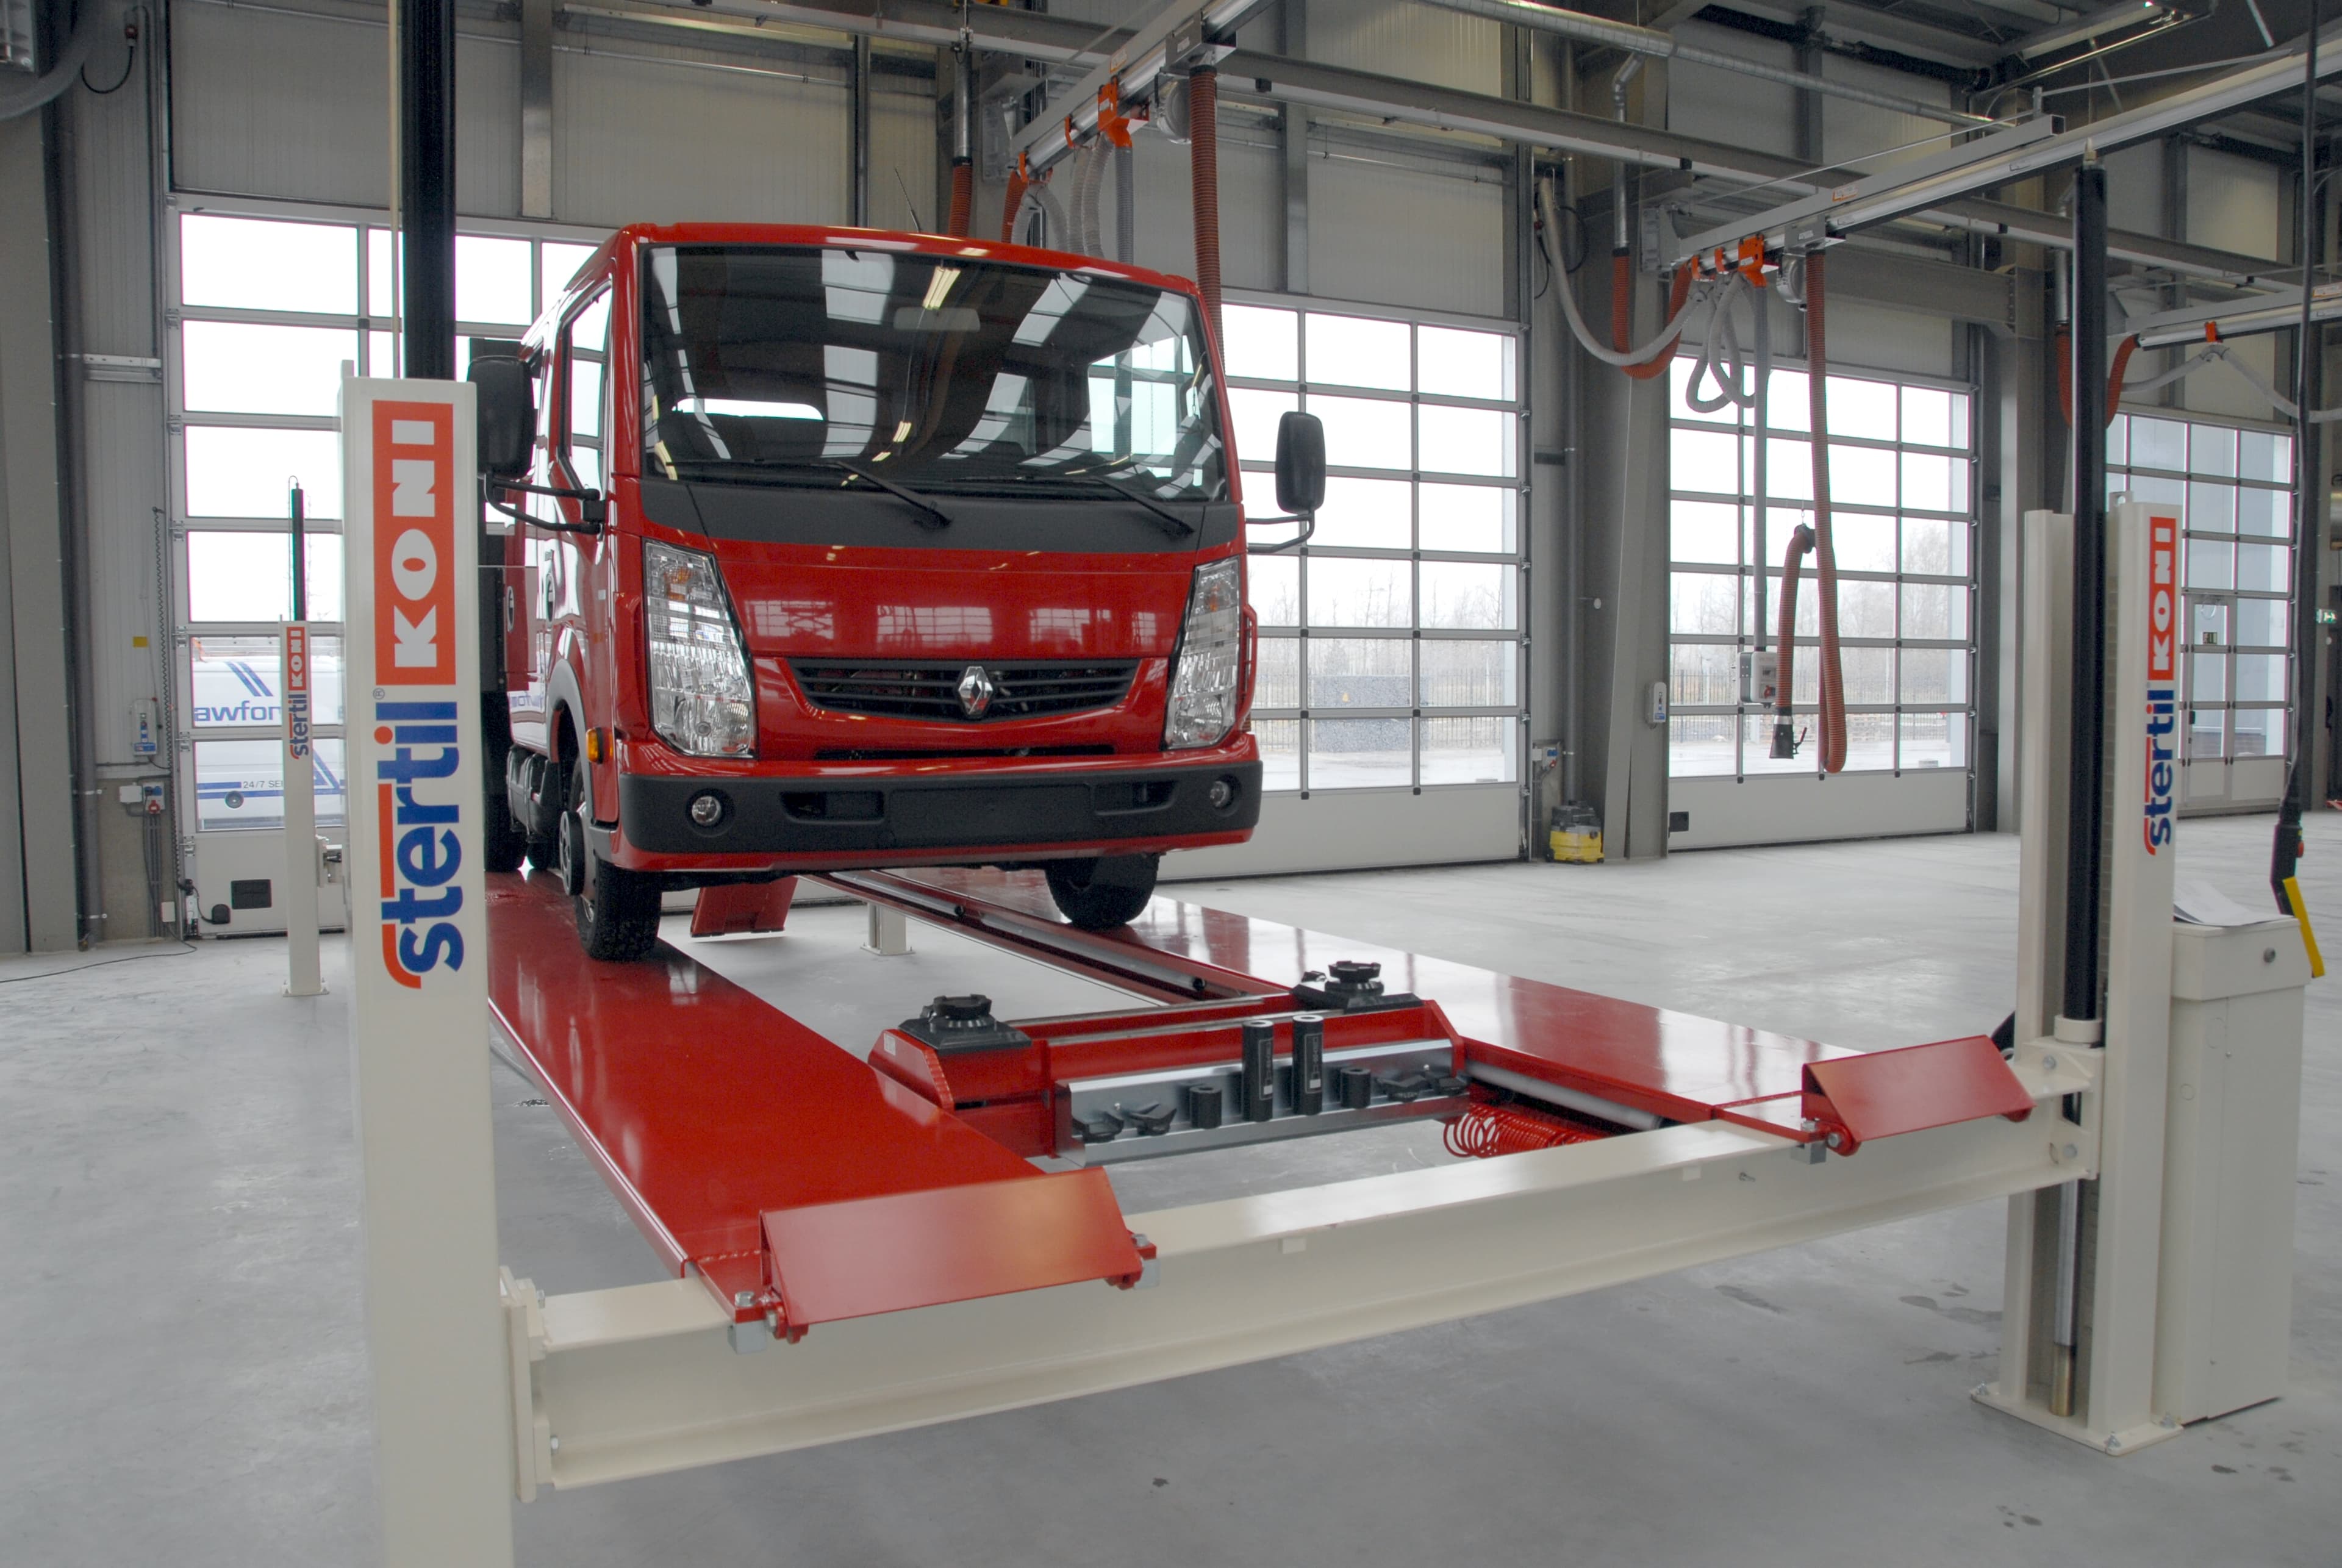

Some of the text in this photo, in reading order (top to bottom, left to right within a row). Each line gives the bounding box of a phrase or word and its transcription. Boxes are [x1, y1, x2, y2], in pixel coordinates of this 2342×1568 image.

[288, 630, 309, 759] stertil KONI
[373, 420, 465, 989] stertil KONI
[2144, 528, 2174, 855] stertil KONI
